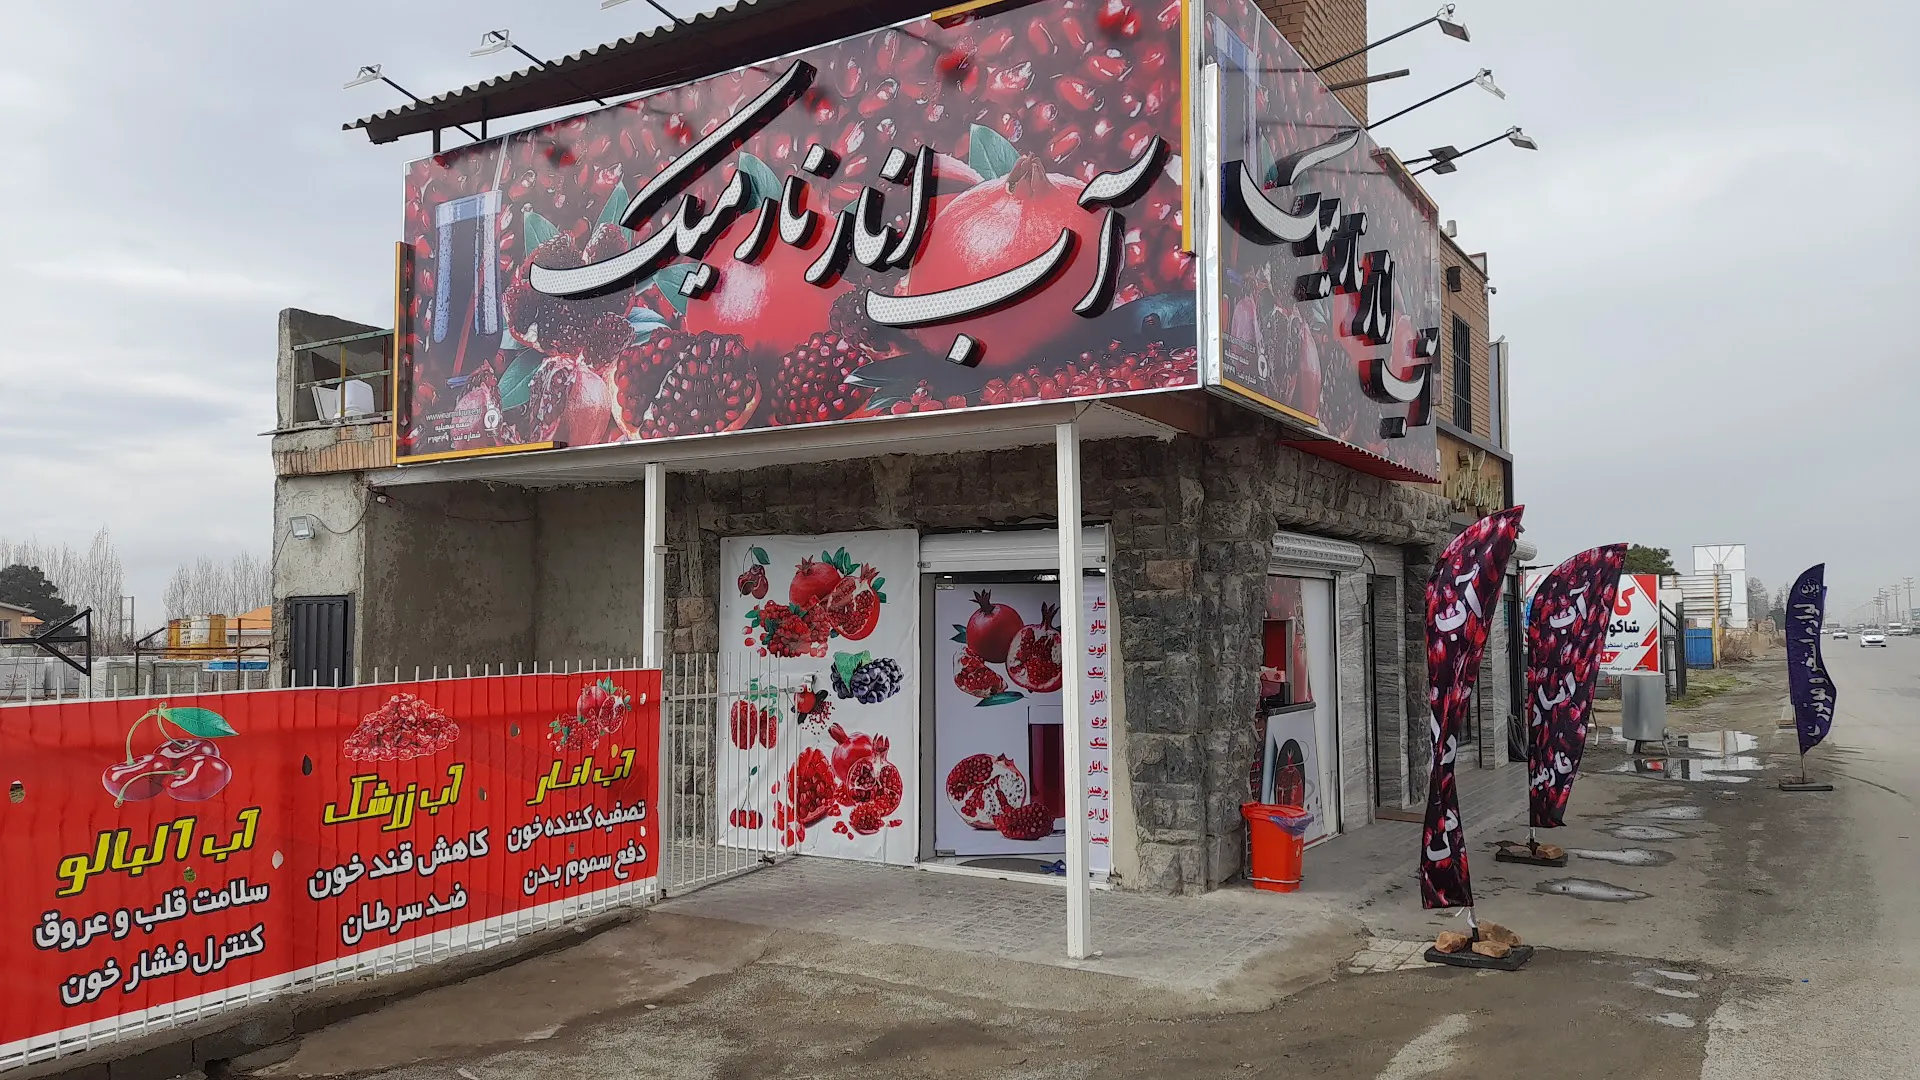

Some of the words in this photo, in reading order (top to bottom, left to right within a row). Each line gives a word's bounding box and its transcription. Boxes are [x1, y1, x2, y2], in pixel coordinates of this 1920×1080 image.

[529, 58, 839, 299] نارمیک
[804, 144, 937, 288] انار
[866, 134, 1169, 368] آب
[1374, 328, 1440, 438] آب
[1435, 562, 1483, 642] آب
[1549, 579, 1591, 635] آب
[1793, 603, 1820, 636] لوازم
[1799, 638, 1825, 675] استخر
[418, 763, 465, 815] آب
[526, 756, 593, 806] انار
[592, 748, 636, 787] آب
[323, 774, 417, 832] زرشک
[544, 804, 593, 837] کننده
[594, 801, 647, 833] تصفیه
[200, 807, 261, 862] آب
[416, 828, 490, 876] کاهش
[506, 815, 544, 853] خون
[56, 817, 197, 897] آلبالو
[308, 854, 366, 899] خون
[368, 841, 414, 879] قند
[522, 864, 562, 895] بدن
[564, 854, 612, 887] سموم
[613, 839, 647, 880] دفع
[134, 888, 188, 933] قلب
[191, 878, 270, 914] سلامت
[424, 883, 468, 917] ضد
[34, 911, 109, 950] عروق
[113, 908, 131, 939] و
[341, 900, 424, 946] سرطان
[124, 942, 189, 991] فشار
[191, 924, 265, 974] کنترل
[60, 958, 122, 1006] خون
